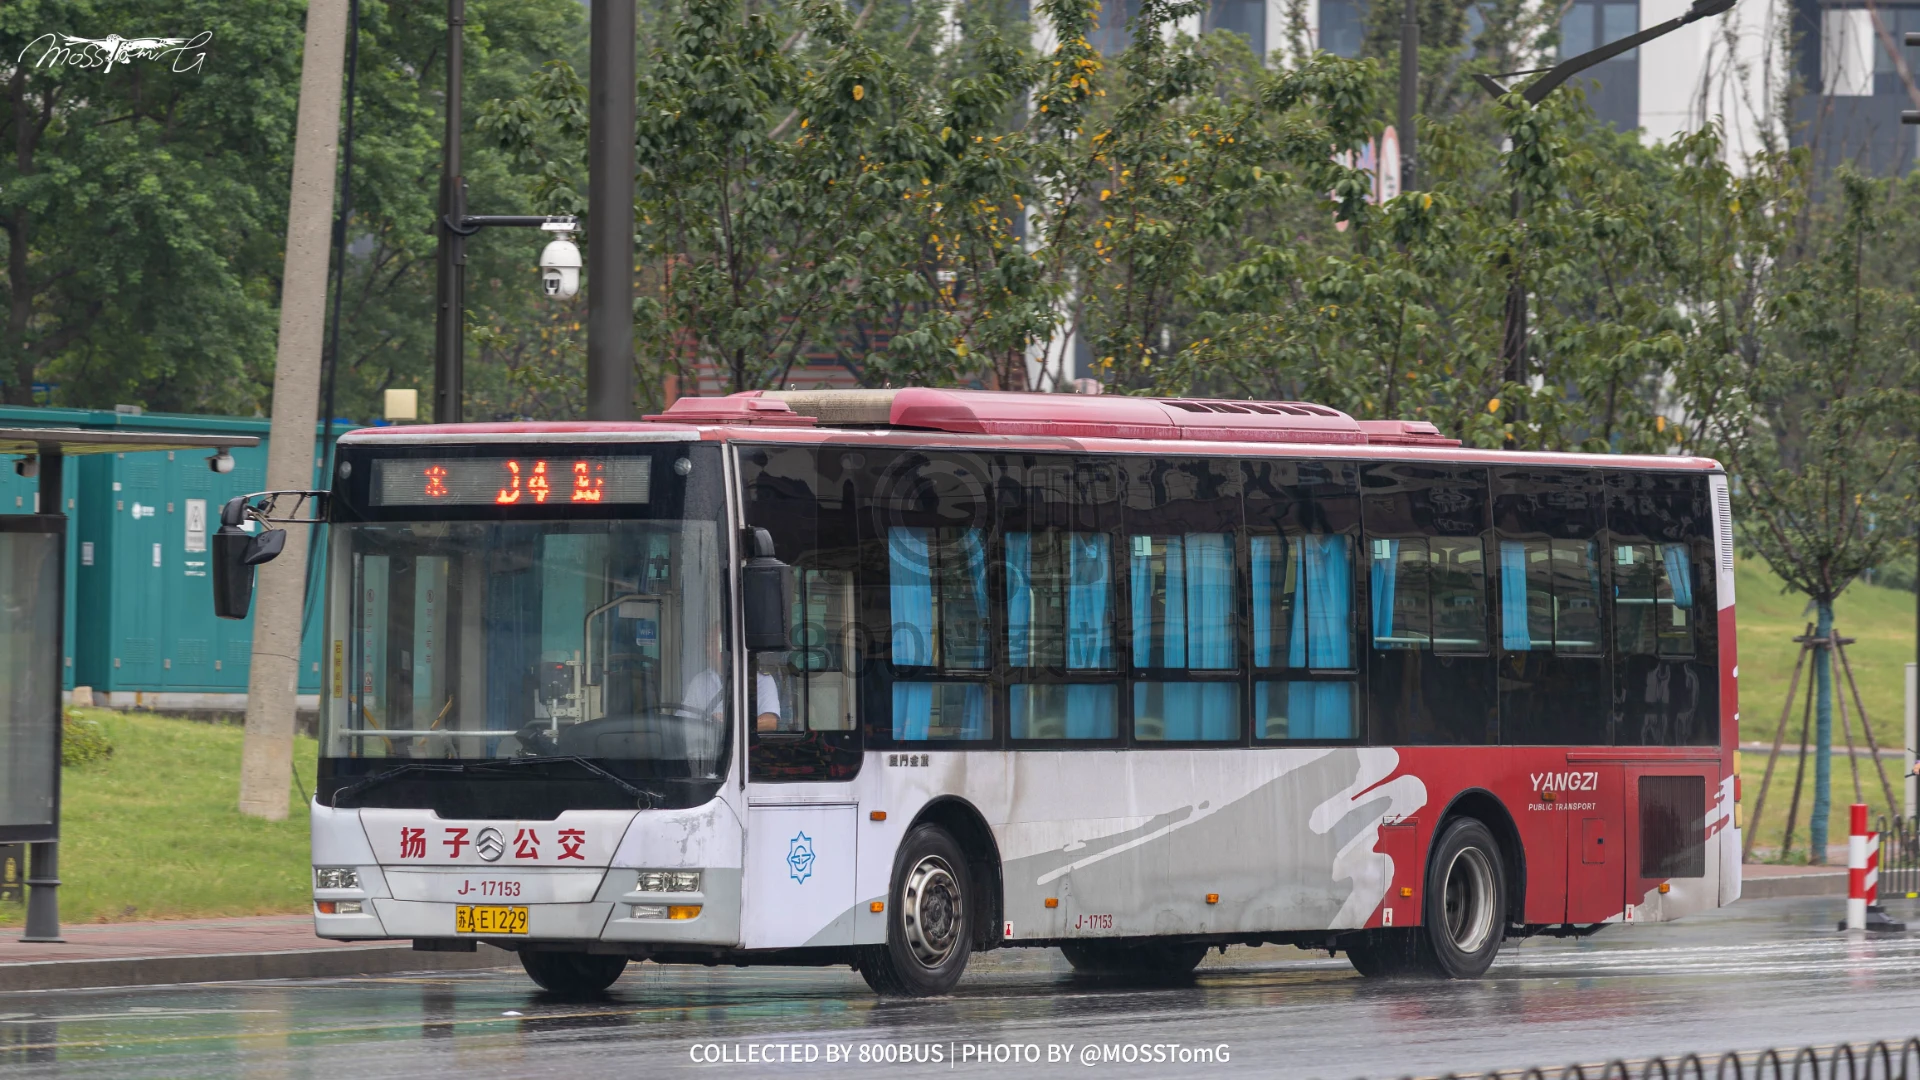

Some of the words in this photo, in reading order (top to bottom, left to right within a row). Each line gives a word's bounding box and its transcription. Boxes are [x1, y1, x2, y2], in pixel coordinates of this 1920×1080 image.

[1530, 771, 1599, 791] YANGZI
[1528, 803, 1553, 811] PUBLIC
[1555, 802, 1597, 811] TRANSPORT
[400, 826, 586, 861] 扬子公交
[1074, 914, 1113, 930] J-17153
